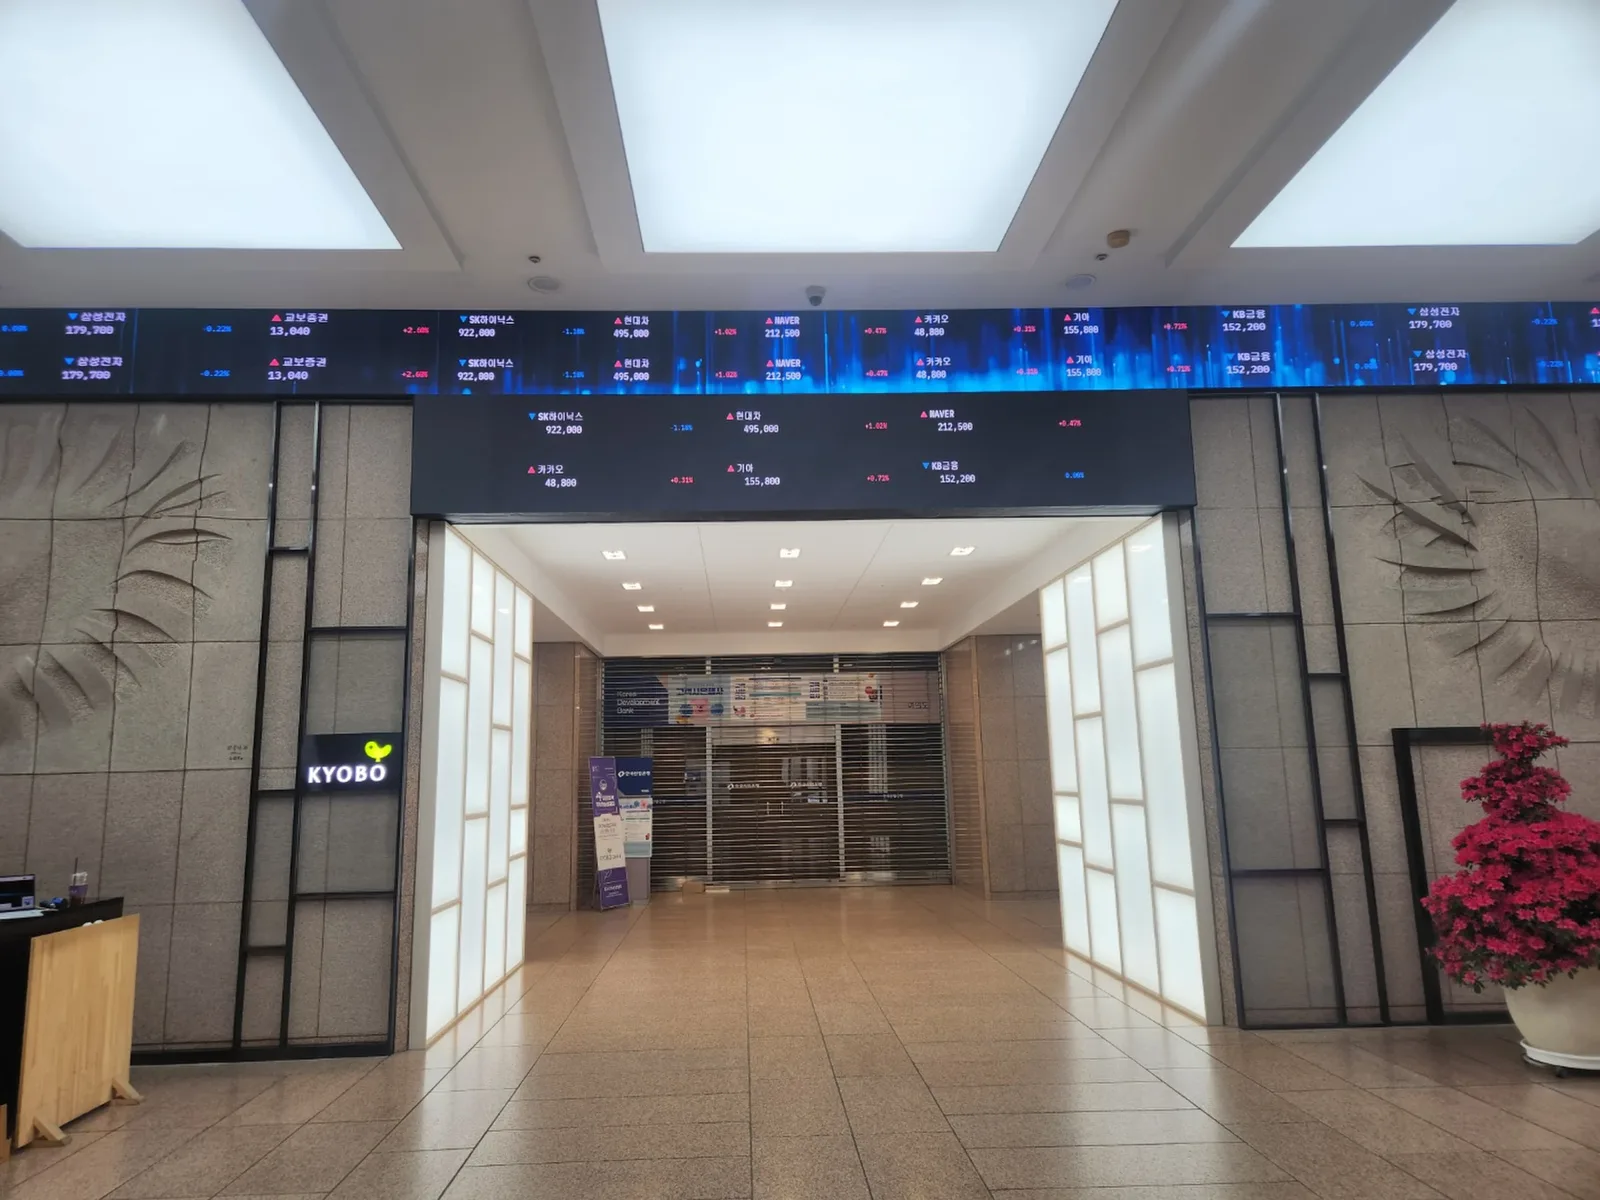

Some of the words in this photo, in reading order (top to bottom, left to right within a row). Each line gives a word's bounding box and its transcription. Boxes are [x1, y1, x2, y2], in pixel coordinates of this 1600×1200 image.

[81, 312, 126, 322] 삼성전자
[1073, 312, 1089, 322] 기아
[1233, 310, 1265, 319] KB금융
[1420, 308, 1460, 316] 삼성전자
[284, 312, 328, 323] 교보증권
[469, 315, 514, 325] SK하이닉스
[624, 316, 649, 326] 현대차
[775, 316, 799, 325] NAVER
[924, 314, 948, 324] 카카오
[1223, 323, 1266, 332] 152,200
[1409, 320, 1452, 329] 179,700
[66, 325, 113, 336] 179,700
[270, 326, 310, 337] 13,040
[459, 328, 495, 338] 922,000
[614, 328, 649, 338] 495,000
[765, 328, 800, 338] 212,500
[914, 327, 944, 337] 48,800
[1064, 325, 1098, 335] 155,800
[1238, 352, 1271, 362] KB금융
[1425, 350, 1466, 358] 삼성전자
[77, 357, 122, 367] 삼성전자
[283, 357, 326, 368] 교보증권
[469, 358, 513, 368] SK하이닉스
[624, 359, 649, 369] 현대차
[776, 359, 801, 368] NAVER
[926, 357, 950, 366] 카카오
[1076, 355, 1092, 364] 기아
[1226, 365, 1270, 375] 152,200
[1414, 363, 1458, 372] 179,700
[62, 371, 111, 381] 179,700
[268, 371, 308, 382] 13,040
[458, 372, 494, 382] 922,000
[614, 372, 649, 382] 495,000
[766, 371, 801, 381] 212,500
[916, 369, 946, 379] 48,800
[1067, 368, 1101, 378] 155,800
[538, 412, 583, 421] SK하이닉스
[736, 411, 760, 420] 현대차
[929, 410, 954, 418] NAVER
[546, 426, 582, 434] 922,000
[744, 425, 778, 434] 495,000
[938, 422, 973, 432] 212,500
[538, 464, 563, 474] 카카오
[737, 464, 753, 473] 기아
[932, 461, 958, 470] KB금융
[545, 478, 576, 487] 48,800
[745, 477, 780, 486] 155,800
[940, 475, 975, 484] 152,200
[308, 764, 386, 783] KYOBO
